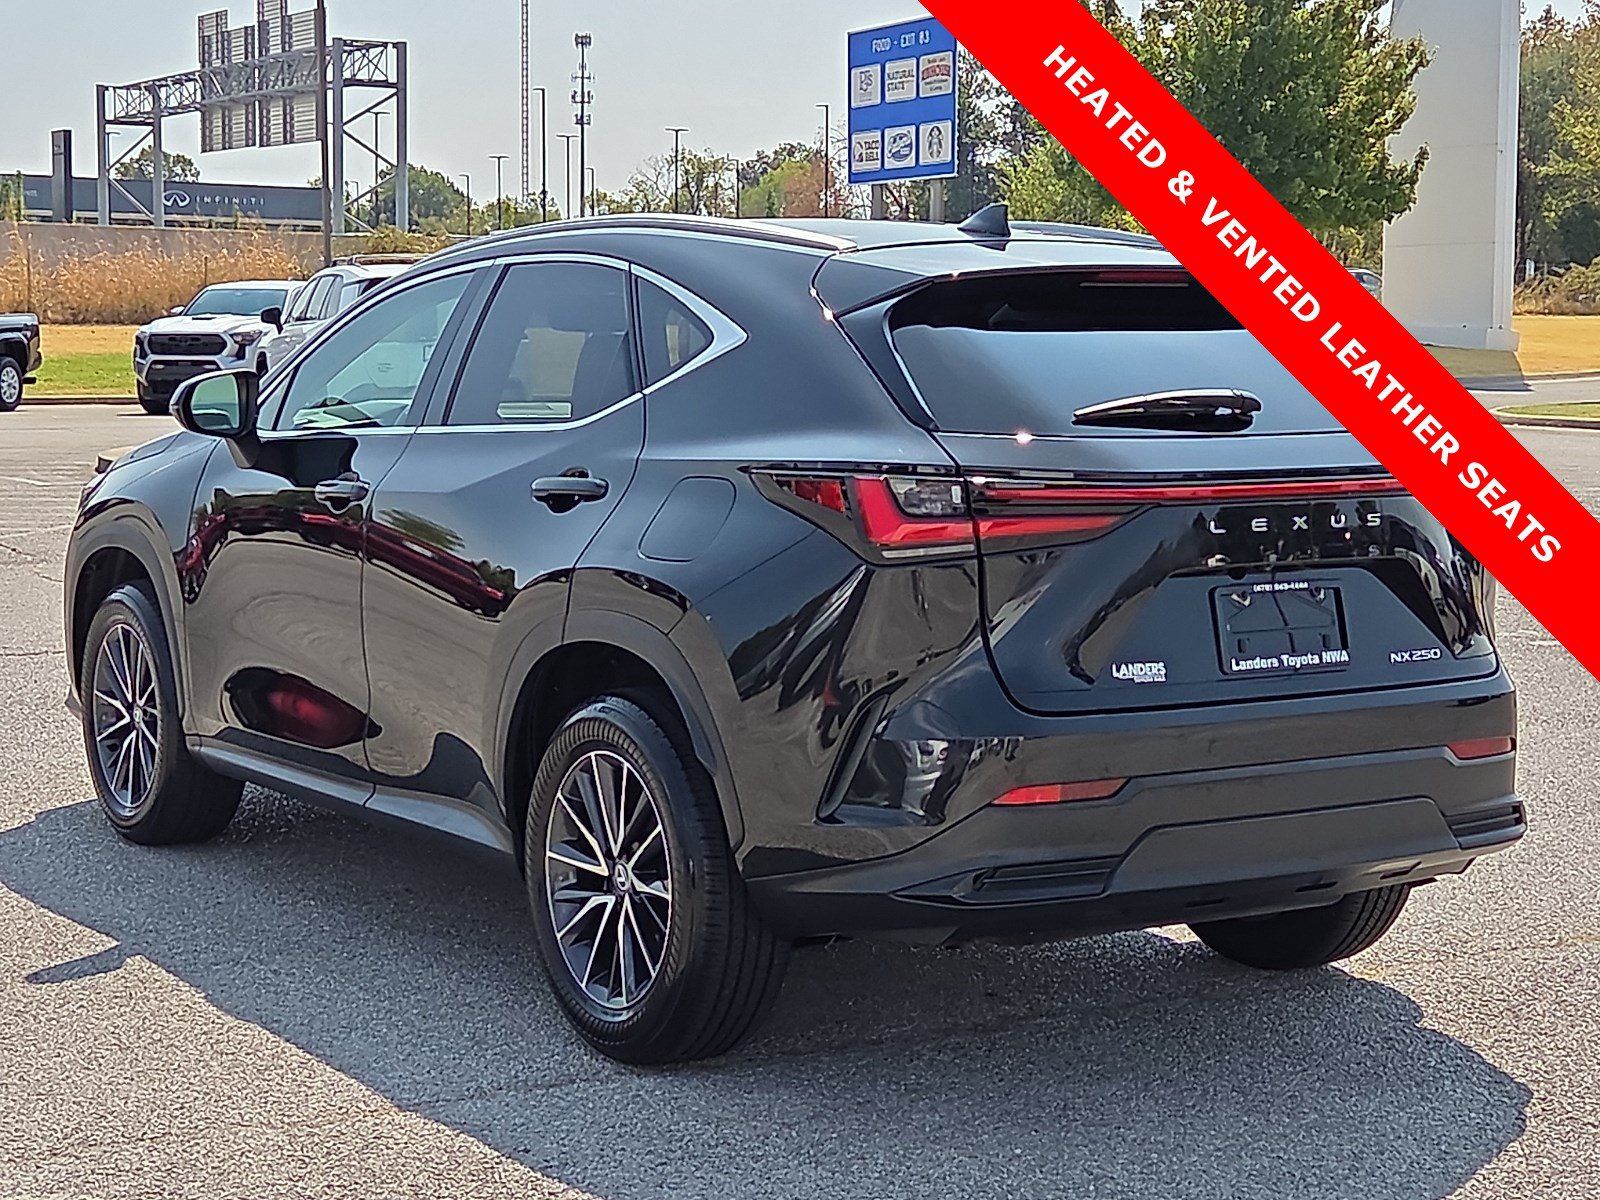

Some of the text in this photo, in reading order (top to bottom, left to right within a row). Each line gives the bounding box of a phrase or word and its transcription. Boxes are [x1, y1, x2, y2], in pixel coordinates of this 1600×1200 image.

[886, 69, 915, 81] NATURAL
[886, 80, 905, 92] STATE
[863, 139, 880, 151] TACO
[864, 151, 880, 162] BELL
[195, 195, 266, 206] INFINITI
[1209, 512, 1382, 534] LEXUS
[1231, 649, 1350, 671] Landers Toyota NWA
[1111, 661, 1167, 679] LANDERS
